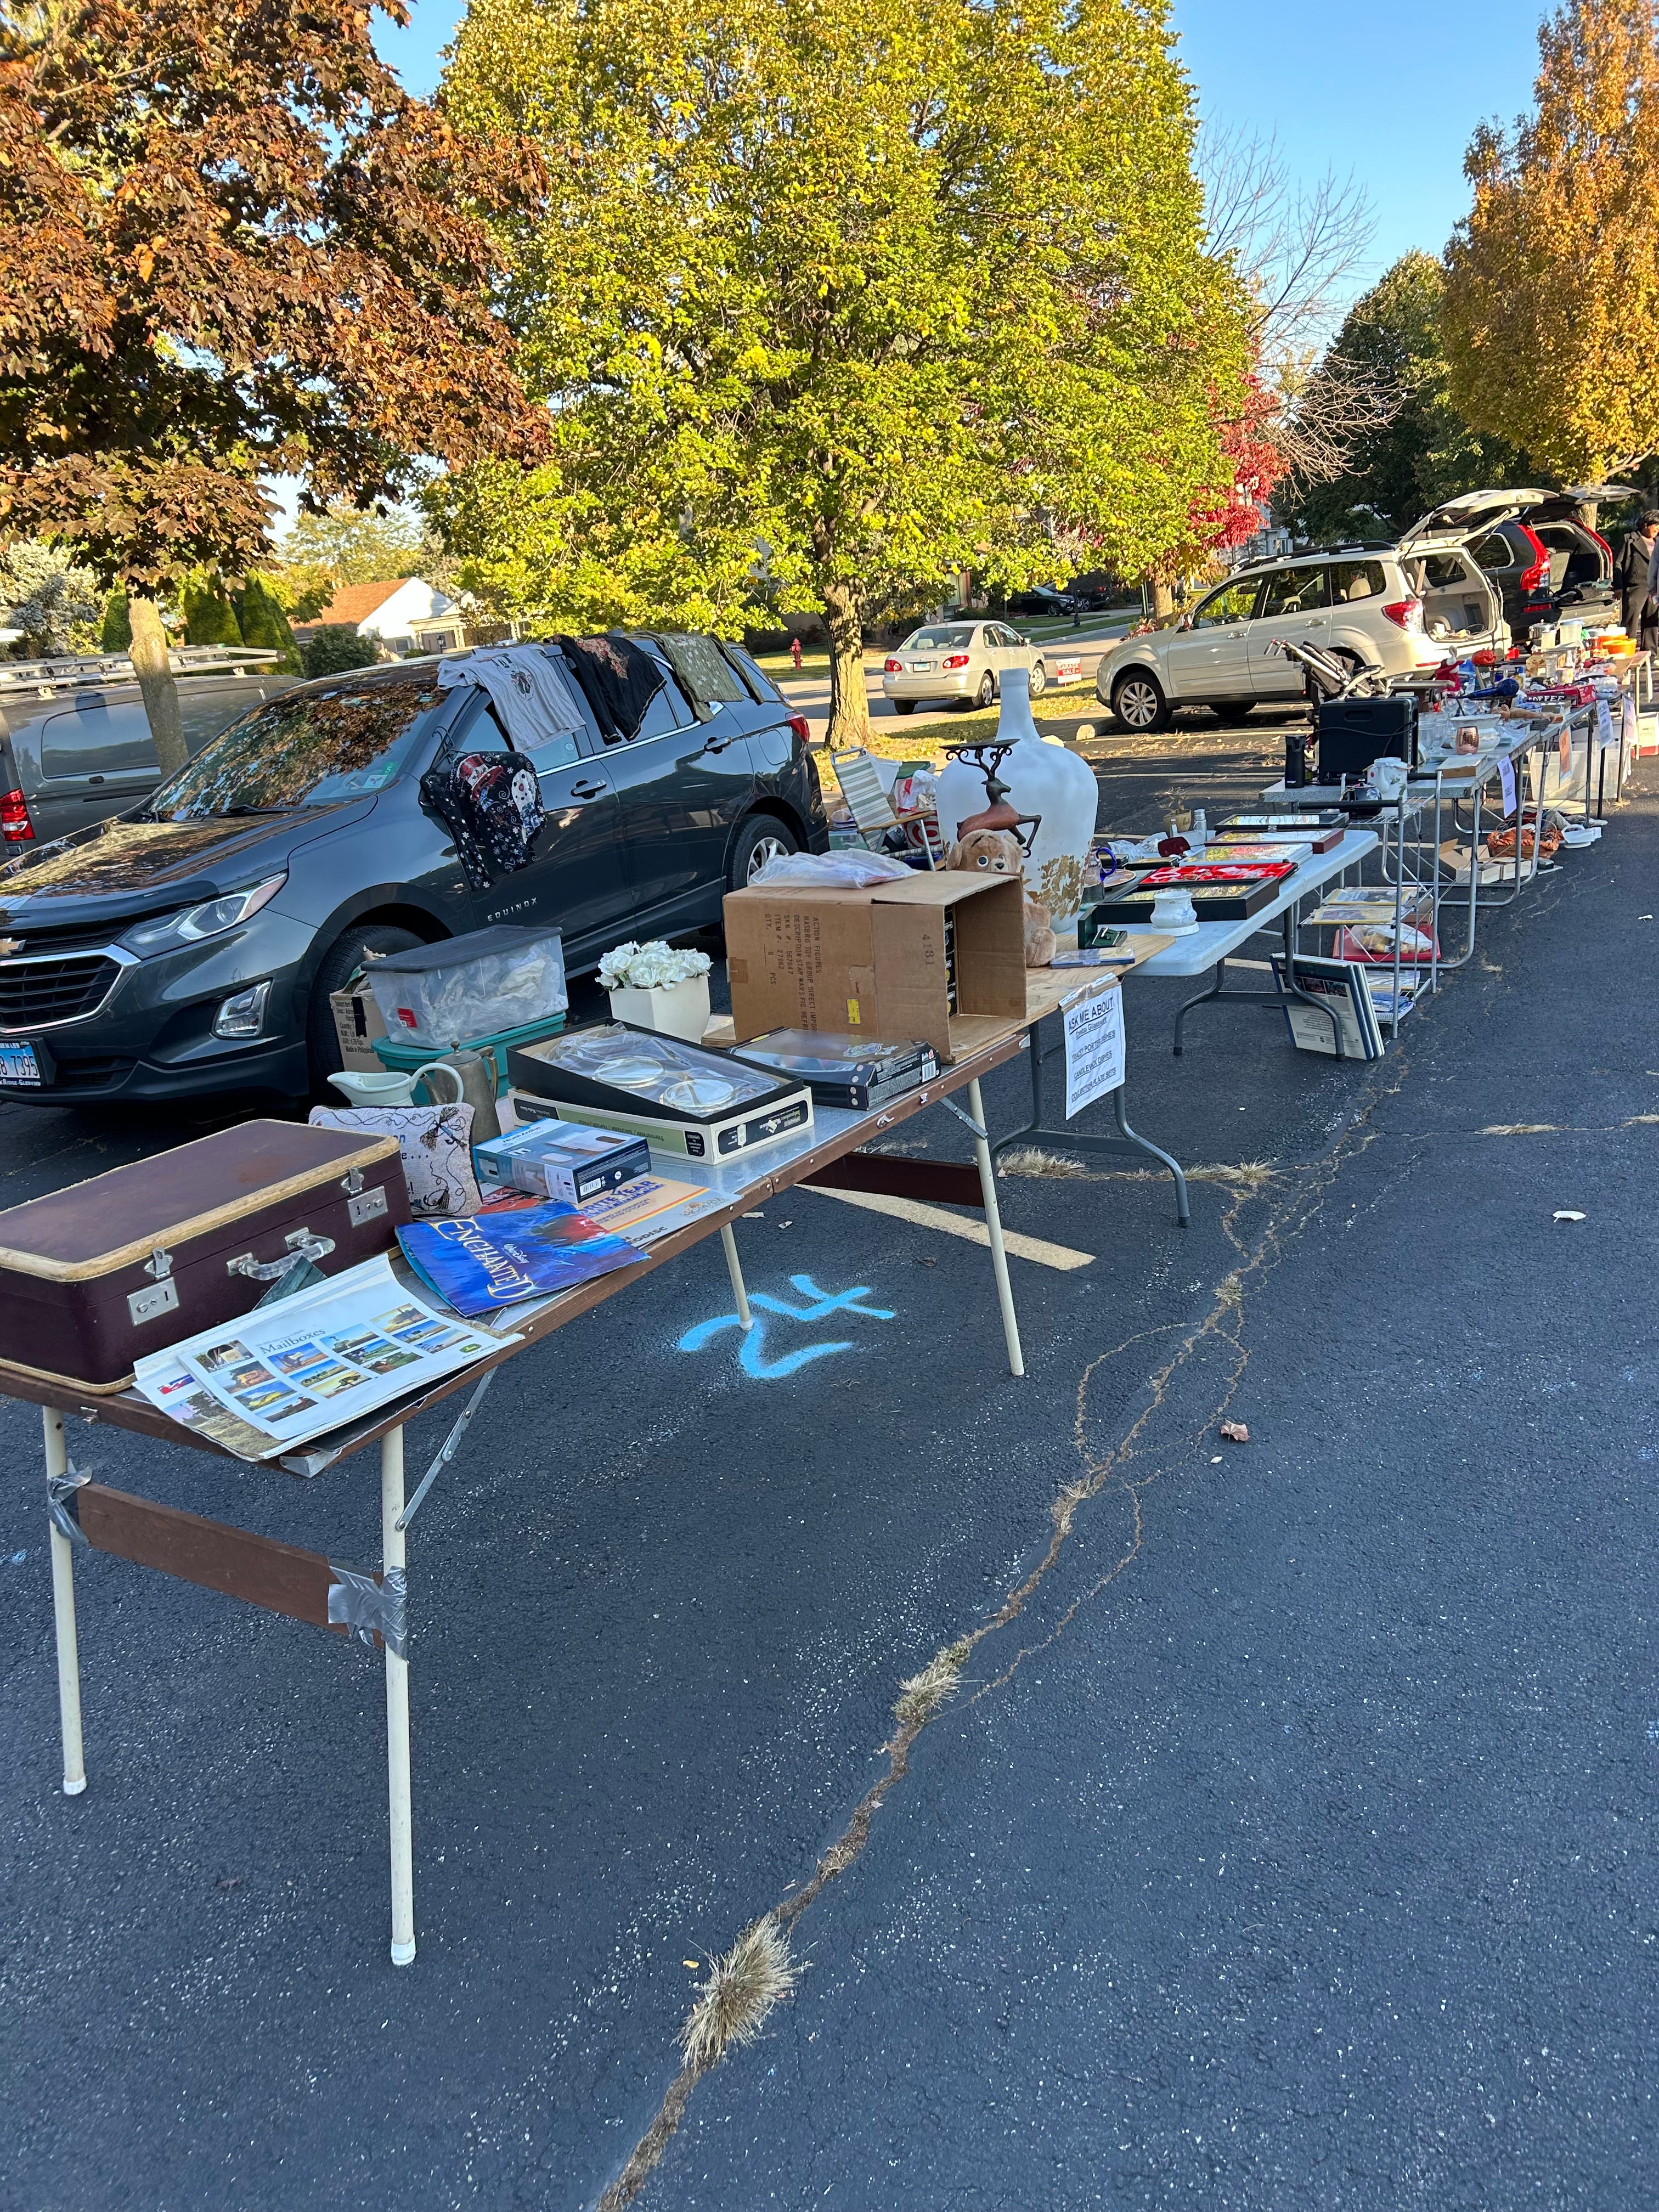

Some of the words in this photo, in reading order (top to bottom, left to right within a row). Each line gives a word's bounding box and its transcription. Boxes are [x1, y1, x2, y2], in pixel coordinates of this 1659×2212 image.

[487, 897, 537, 922] EQUINOX
[1069, 1015, 1079, 1032] ASK
[1080, 1009, 1090, 1024] ME
[1092, 996, 1113, 1018] ABOUT
[10, 1056, 38, 1076] 7395
[1098, 1050, 1113, 1063] DISHES
[1105, 1067, 1116, 1078] SETS
[610, 1180, 658, 1197] YEAR
[427, 1216, 534, 1299] ENCHANTED
[259, 1329, 326, 1355] Mailboxes
